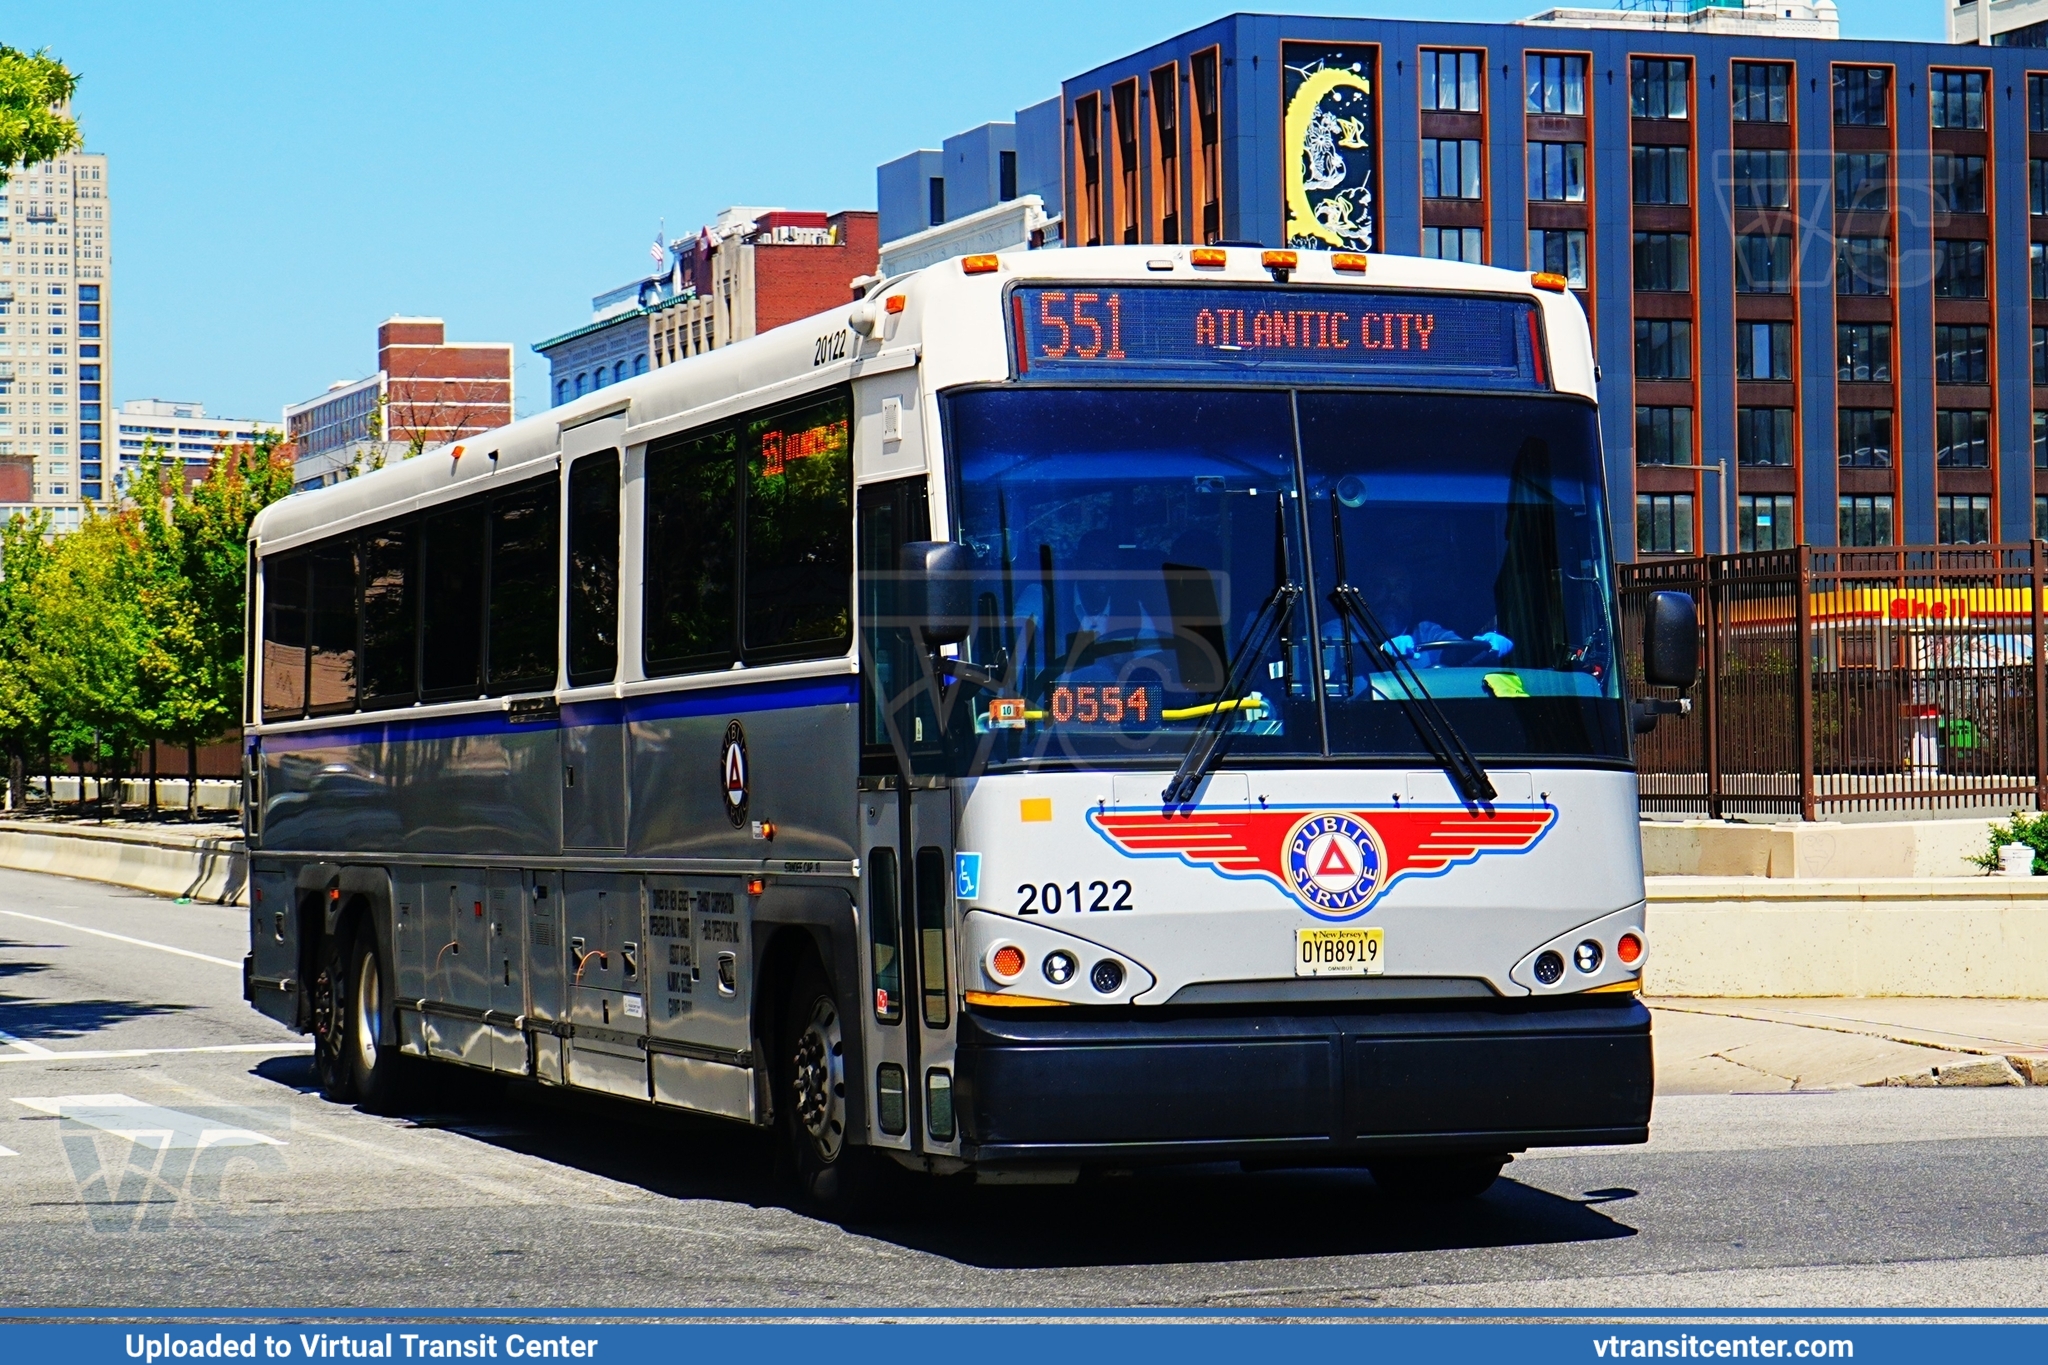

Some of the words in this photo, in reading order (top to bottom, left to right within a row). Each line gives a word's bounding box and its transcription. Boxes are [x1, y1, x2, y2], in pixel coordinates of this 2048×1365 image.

[1040, 292, 1126, 359] 551
[1196, 308, 1350, 349] ATLANTIC
[1361, 312, 1435, 351] CITY
[814, 329, 847, 367] 20122
[1889, 597, 1967, 619] Shell
[1052, 686, 1149, 722] 0554
[1292, 817, 1375, 857] PUBLIC
[1017, 879, 1133, 916] 20122
[1293, 867, 1378, 908] SERVICE
[1319, 931, 1338, 939] New
[1338, 930, 1362, 939] Jersey
